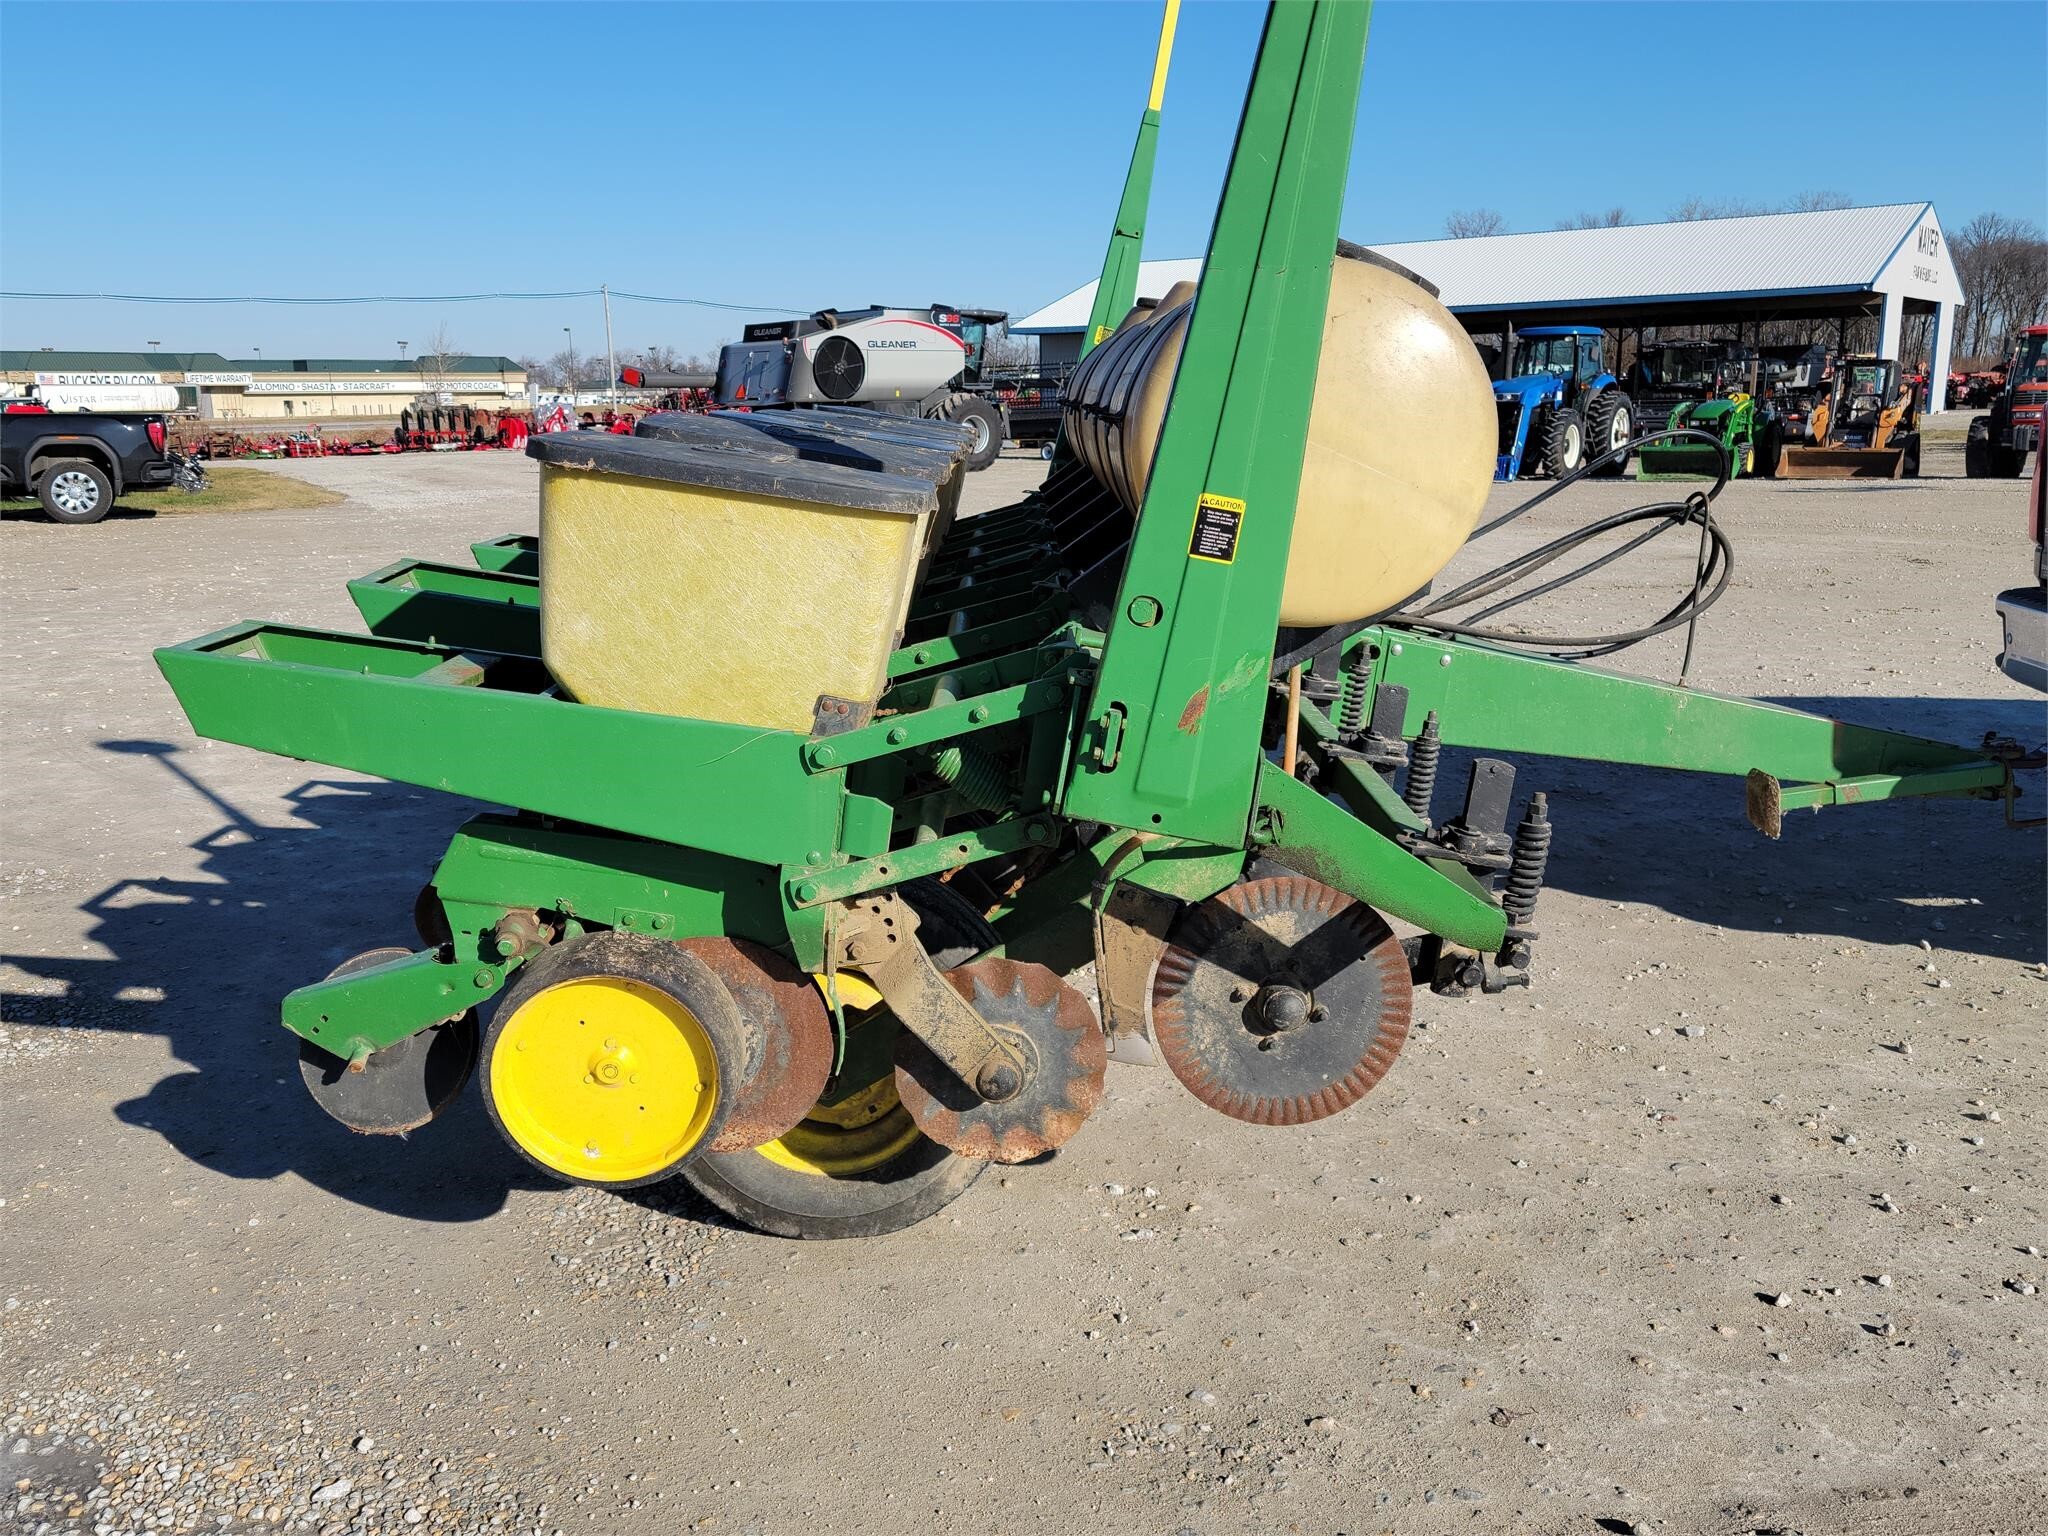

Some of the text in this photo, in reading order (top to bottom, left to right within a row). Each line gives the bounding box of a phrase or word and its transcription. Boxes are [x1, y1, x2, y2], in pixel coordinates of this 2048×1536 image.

[867, 340, 917, 348] GLEANER
[186, 374, 252, 383] LIFETIME WARRANTY
[247, 382, 391, 391] PALOMINO SHASTA STARCRAFT
[446, 382, 473, 390] MOTOR
[473, 382, 498, 390] COACH
[1209, 498, 1243, 510] CAUTION
